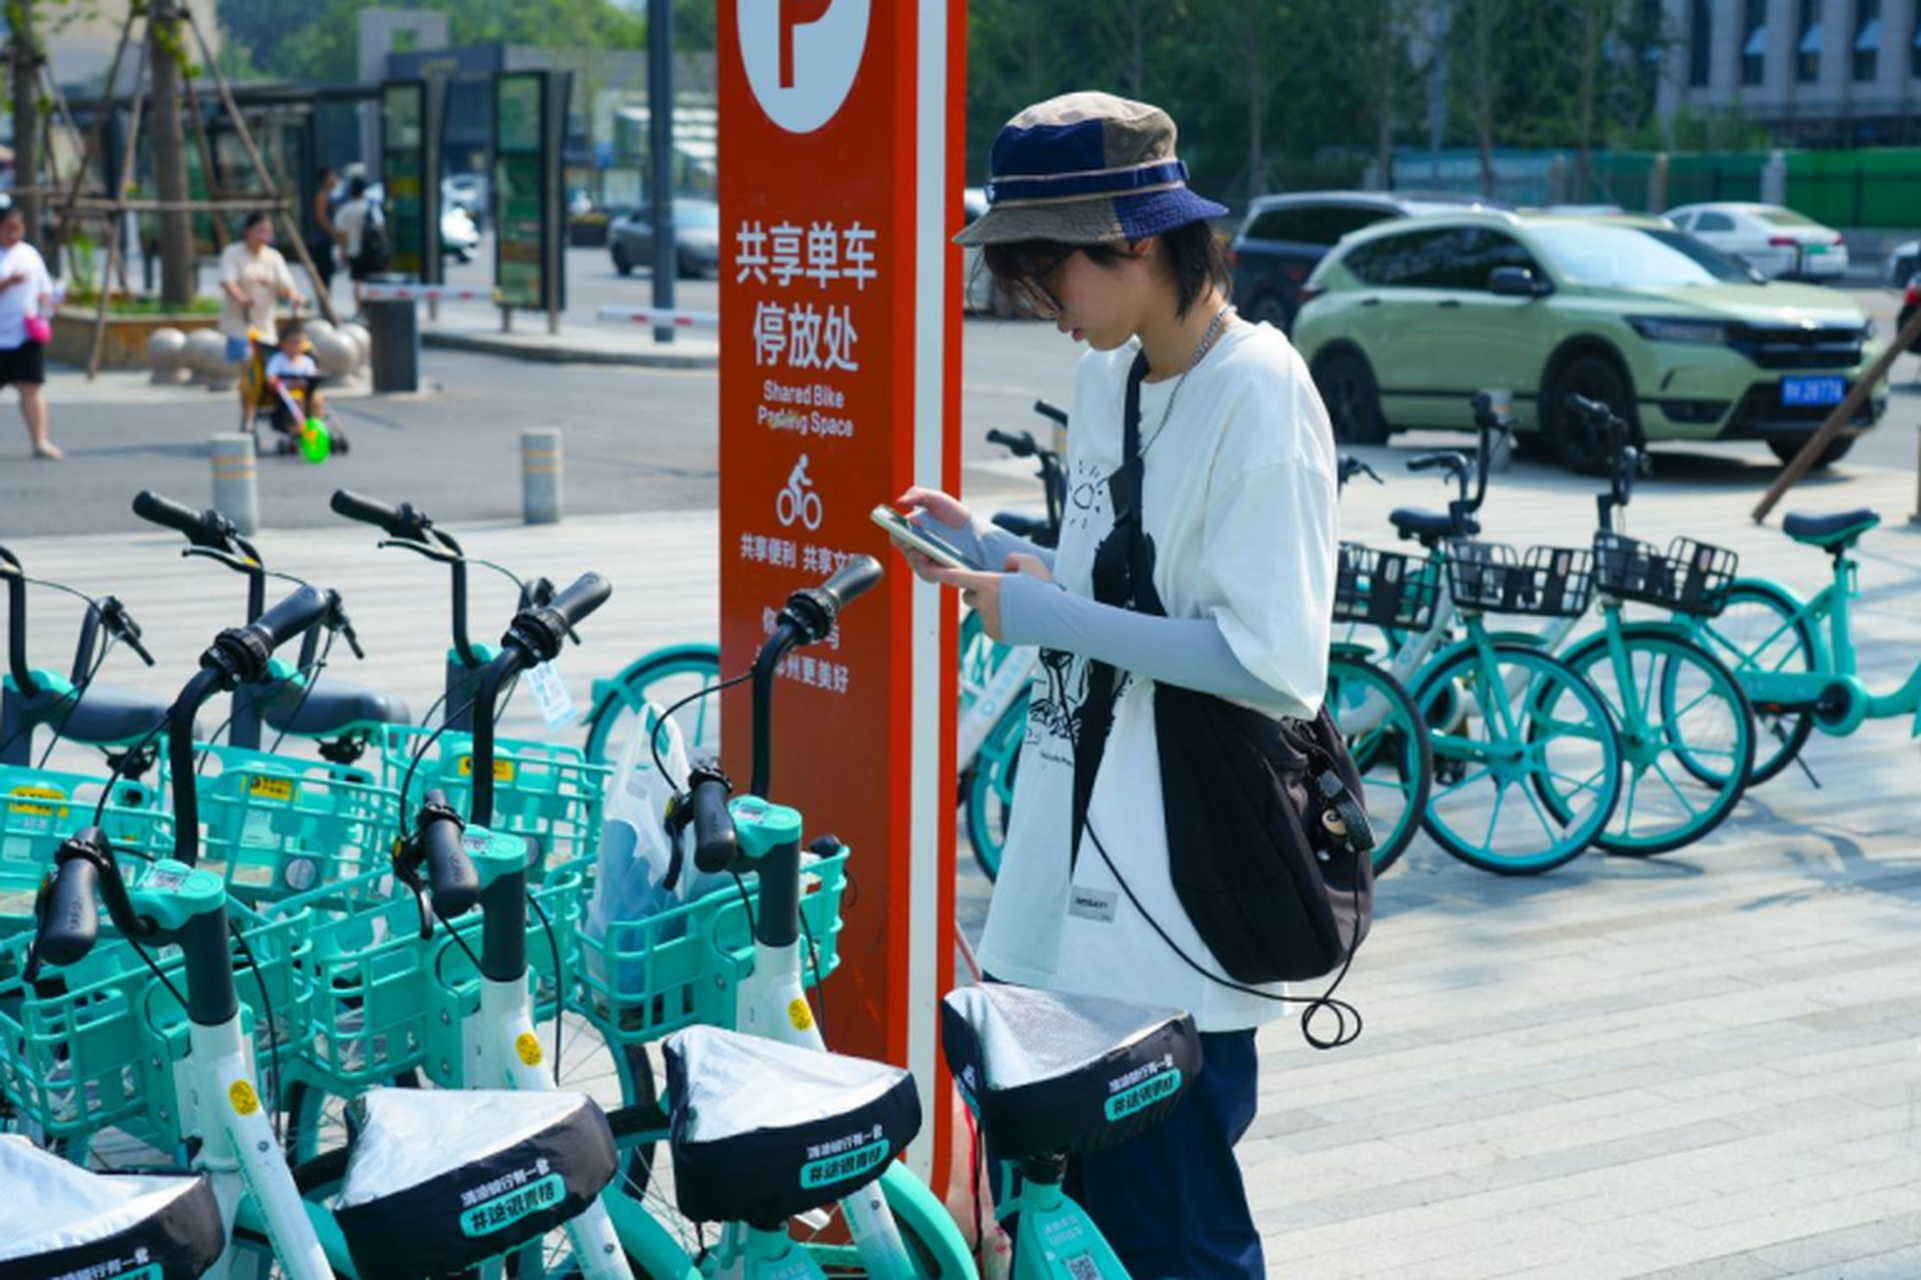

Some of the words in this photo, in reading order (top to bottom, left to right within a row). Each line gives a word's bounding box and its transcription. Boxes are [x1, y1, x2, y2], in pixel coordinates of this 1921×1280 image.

[735, 220, 878, 291] 共享单车
[753, 301, 859, 372] 停放处
[763, 379, 812, 405] Shared
[813, 384, 845, 410] Bike
[810, 411, 854, 438] Space
